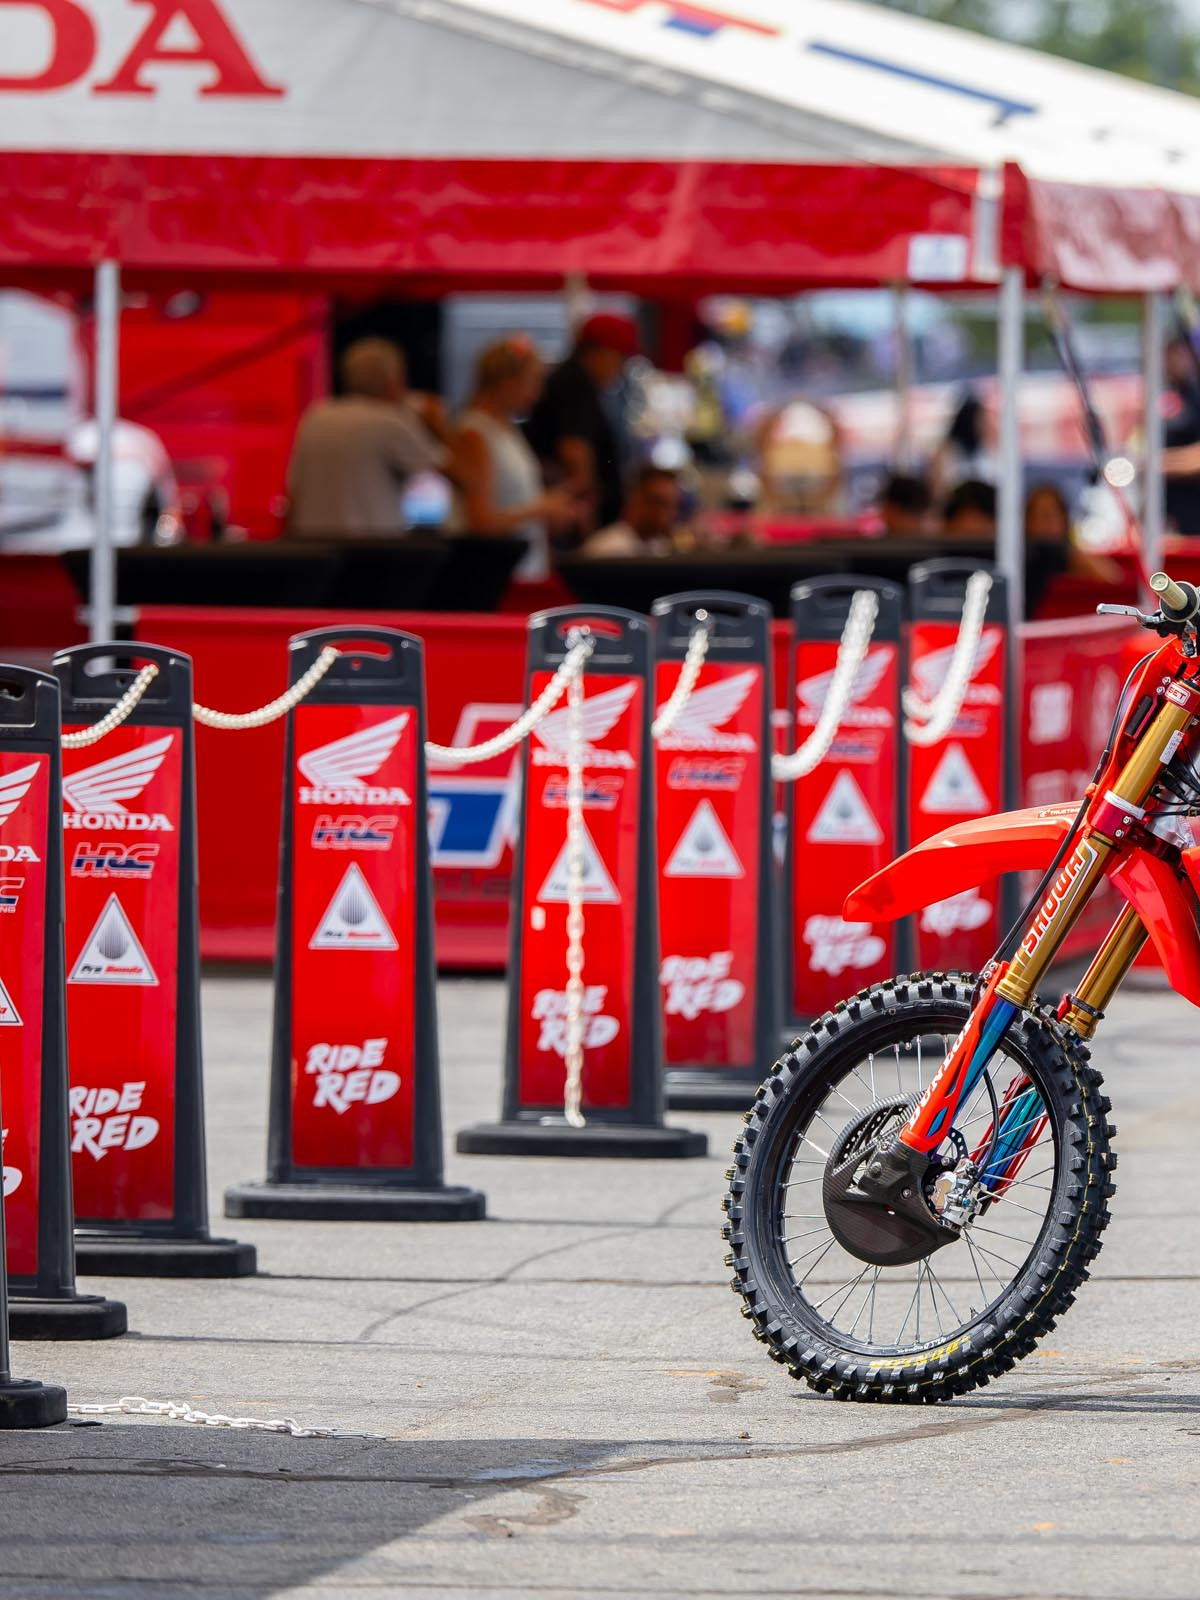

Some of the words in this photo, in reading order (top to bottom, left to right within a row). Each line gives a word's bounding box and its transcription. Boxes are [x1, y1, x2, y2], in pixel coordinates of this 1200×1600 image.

[298, 786, 412, 805] HONDA
[63, 812, 174, 831] HONDA
[72, 842, 160, 871] HRC
[1022, 848, 1086, 957] SHOWA
[304, 1037, 388, 1074] RIDE
[69, 1081, 146, 1118] RIDE
[312, 1068, 401, 1115] RED
[71, 1114, 160, 1162] RED
